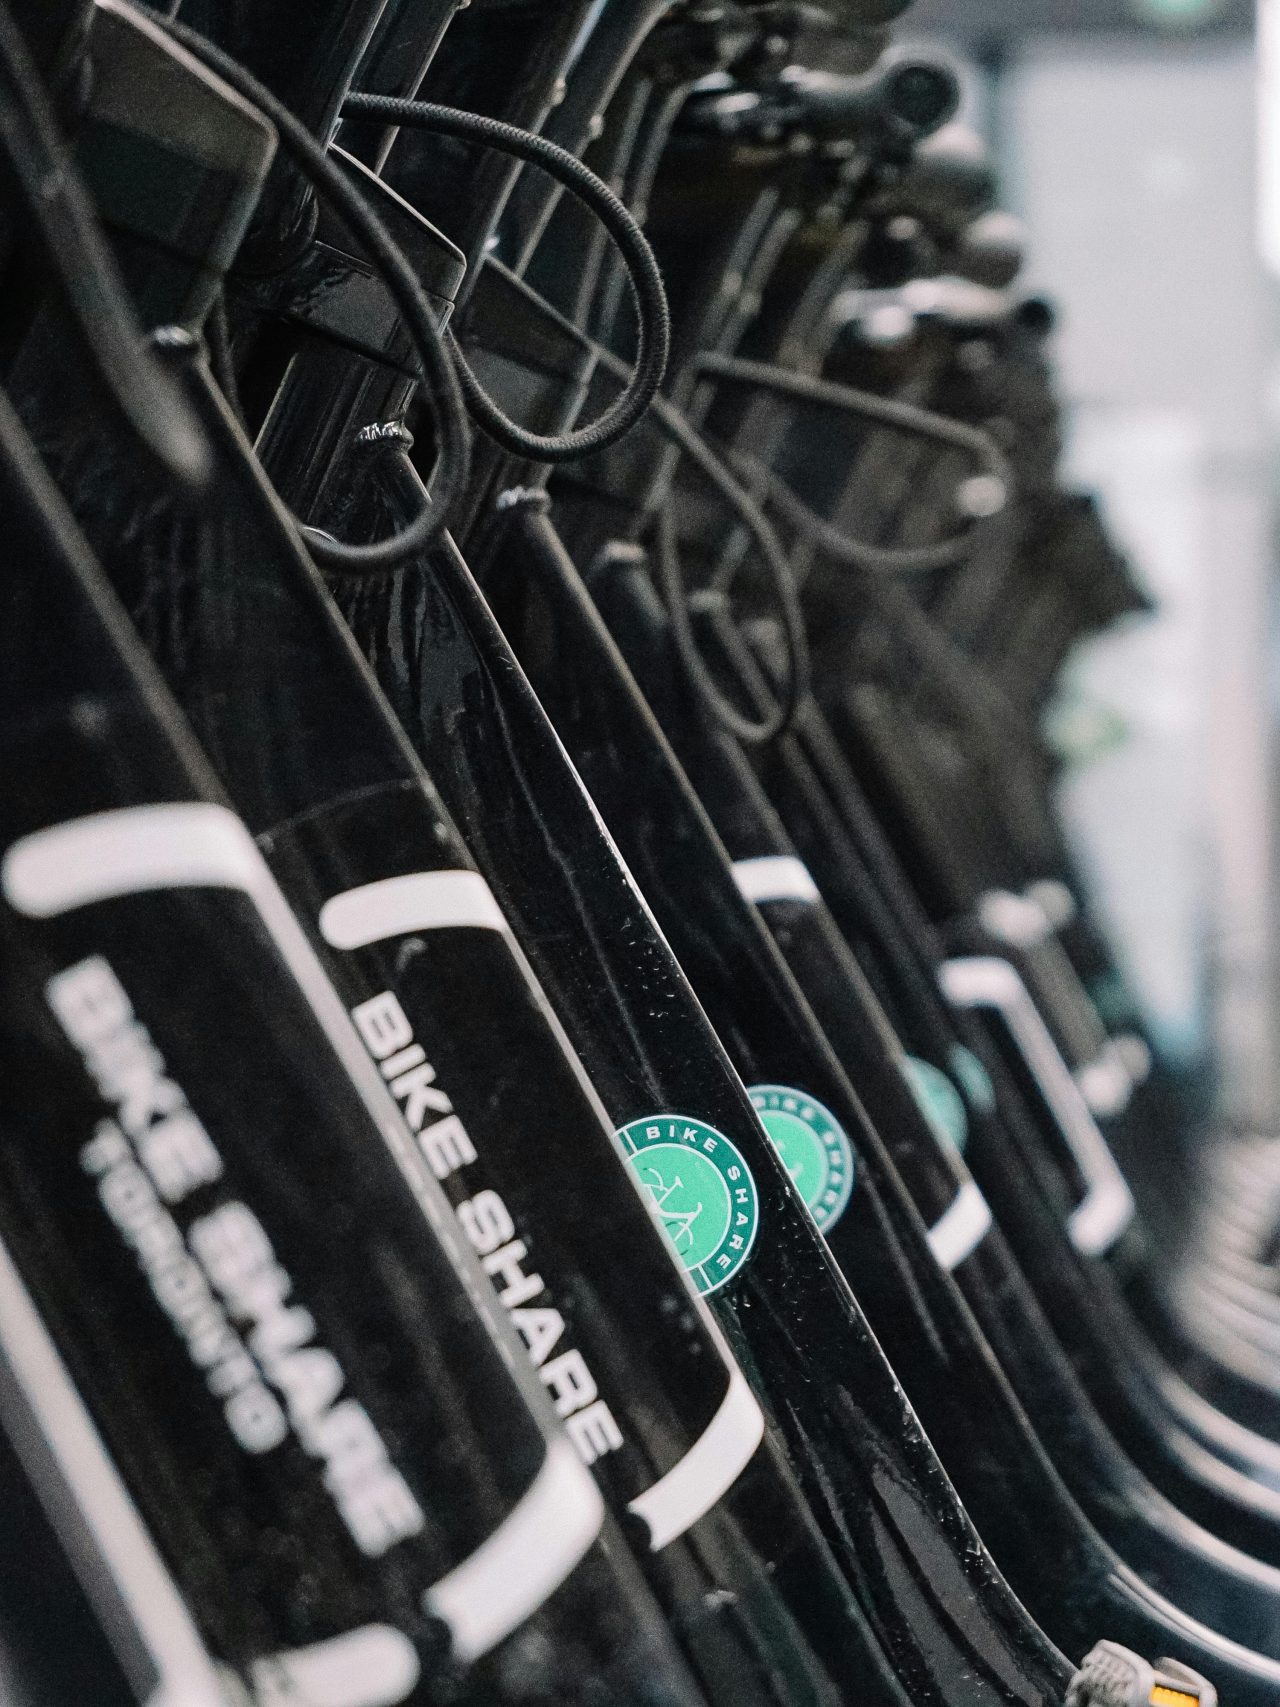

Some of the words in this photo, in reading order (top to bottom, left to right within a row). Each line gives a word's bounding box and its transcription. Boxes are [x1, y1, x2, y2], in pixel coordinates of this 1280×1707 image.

[45, 953, 225, 1204] BIKE
[187, 1200, 426, 1559] SHARE
[79, 1116, 289, 1454] TORONTO
[351, 990, 479, 1180] BIKE
[455, 1189, 625, 1465] SHARE
[646, 1125, 718, 1153] BIKE
[715, 1165, 750, 1270] SHARE
